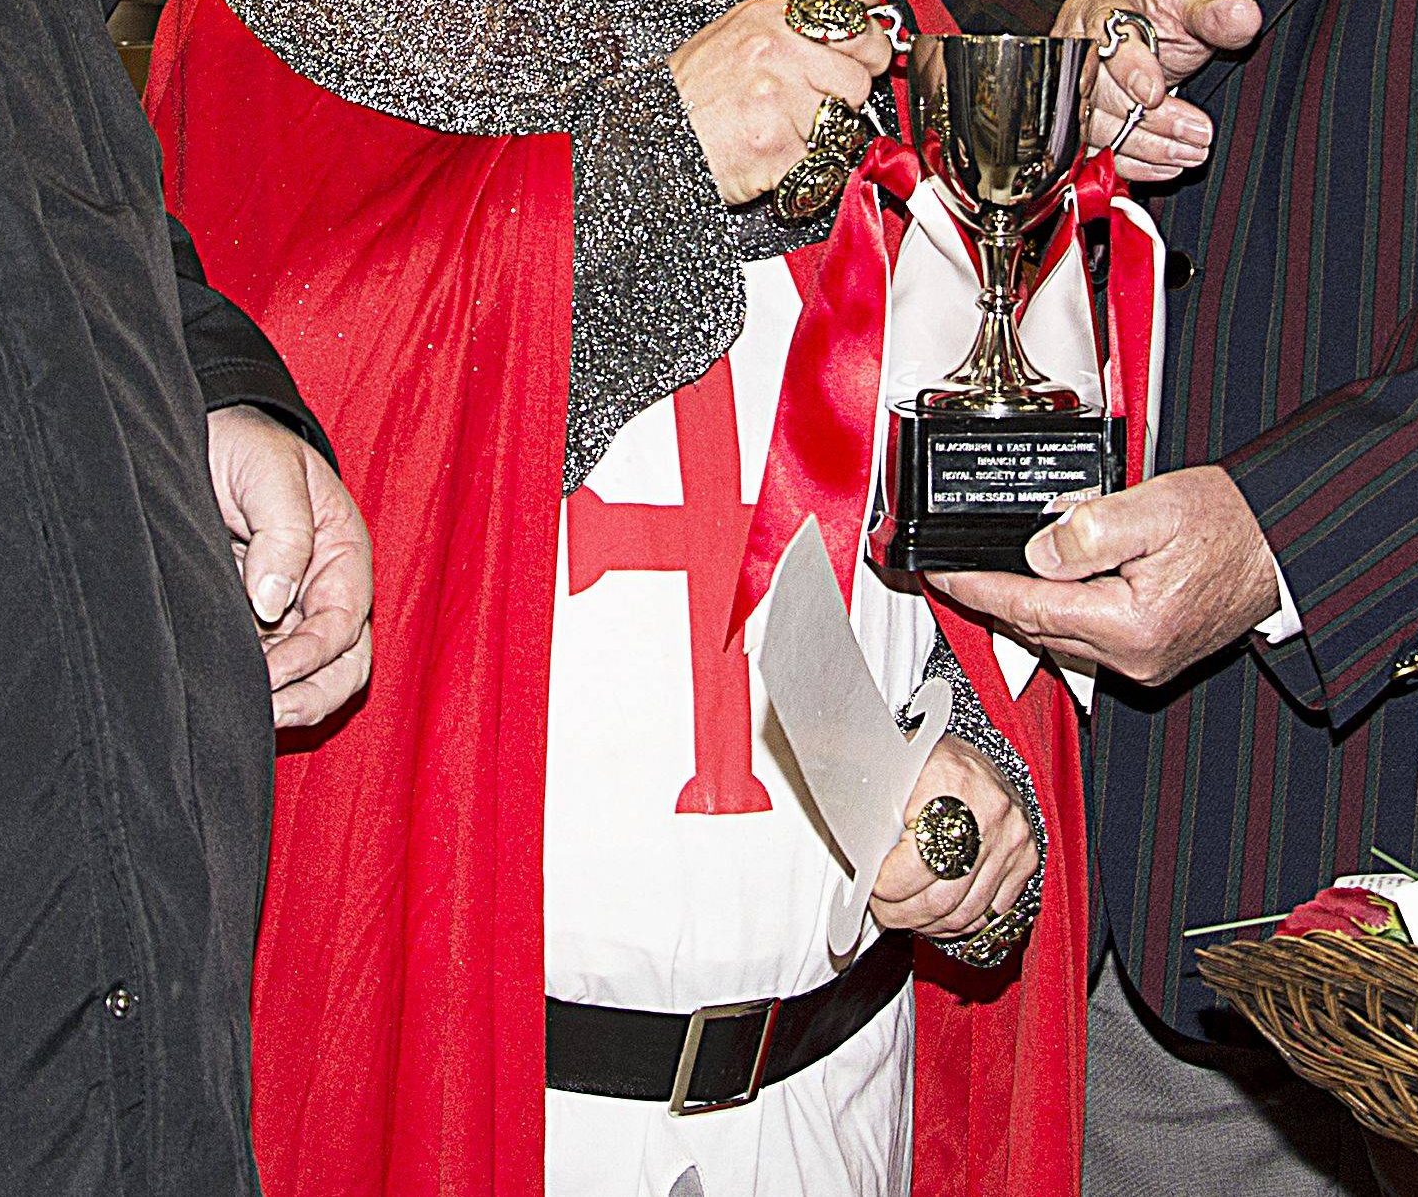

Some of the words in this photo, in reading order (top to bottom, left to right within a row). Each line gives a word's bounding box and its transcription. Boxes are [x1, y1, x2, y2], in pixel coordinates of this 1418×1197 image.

[935, 443, 992, 452] BLACKBURN
[1006, 443, 1032, 452] EAST
[977, 457, 1016, 465] BRANCH
[1019, 457, 1033, 465] OF
[975, 471, 1016, 480] SOCIETY
[1018, 471, 1032, 480] OF
[934, 492, 962, 502] BEST
[965, 492, 1015, 502] DRESSED
[1018, 492, 1058, 502] MARKET
